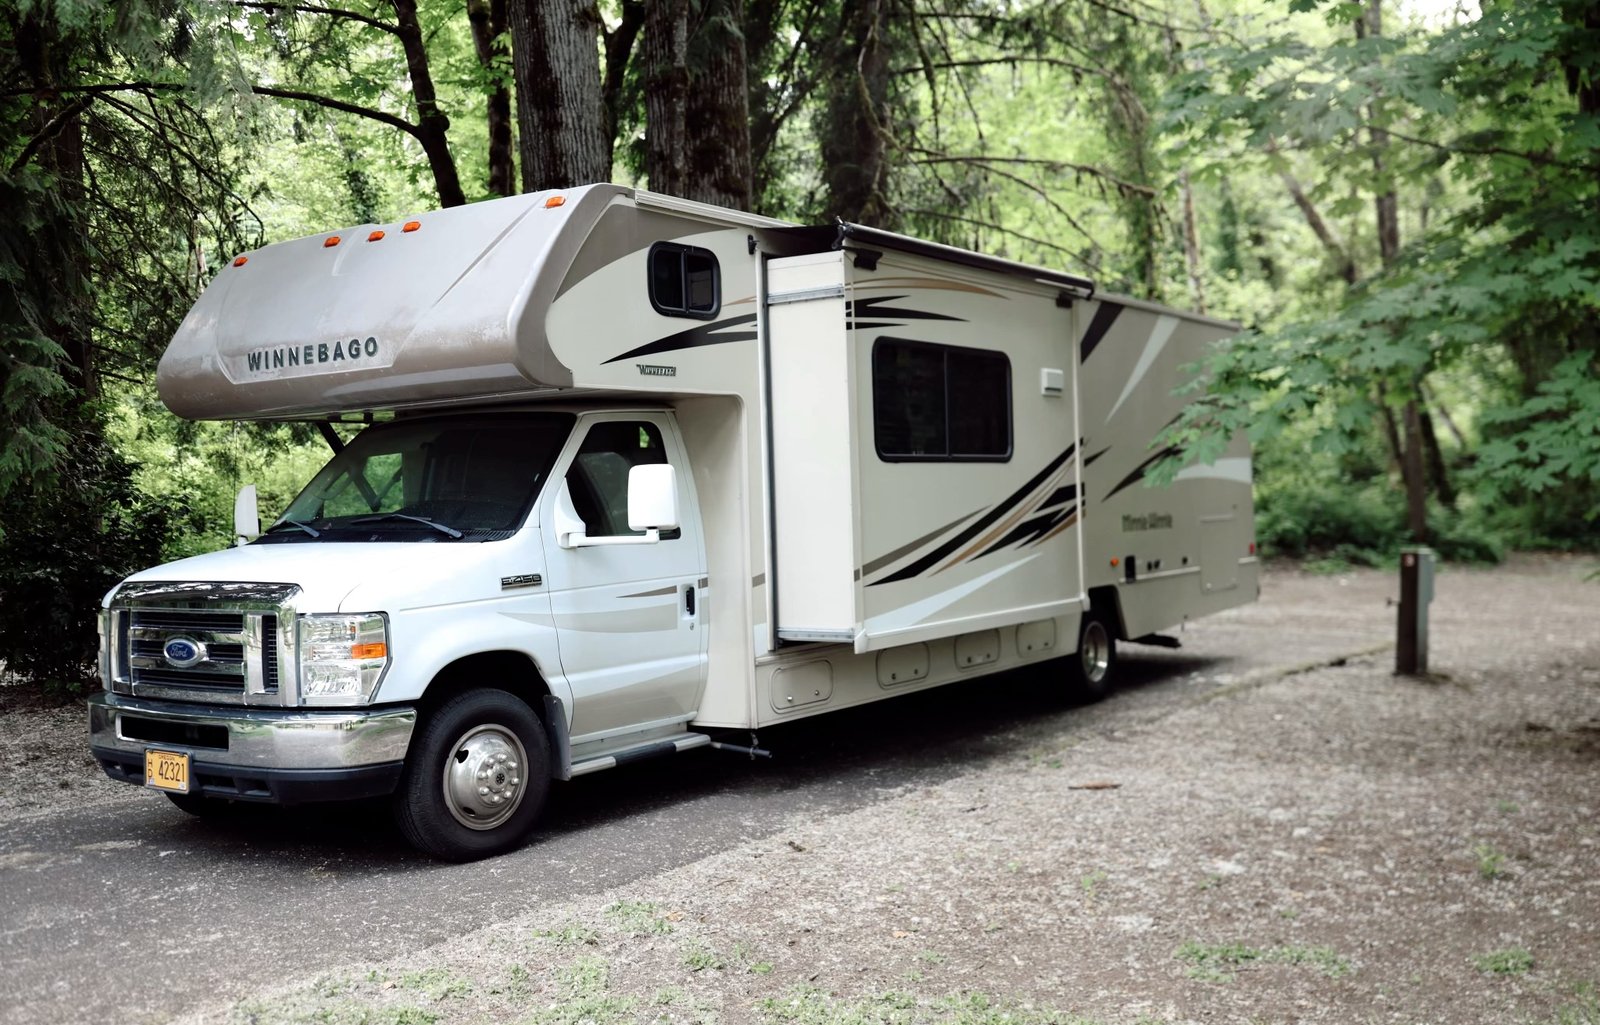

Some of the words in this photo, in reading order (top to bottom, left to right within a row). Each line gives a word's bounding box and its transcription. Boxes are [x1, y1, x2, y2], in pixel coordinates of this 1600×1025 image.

[247, 336, 379, 372] WINNEBAGO
[170, 643, 190, 658] Ford
[158, 760, 185, 782] 42321
